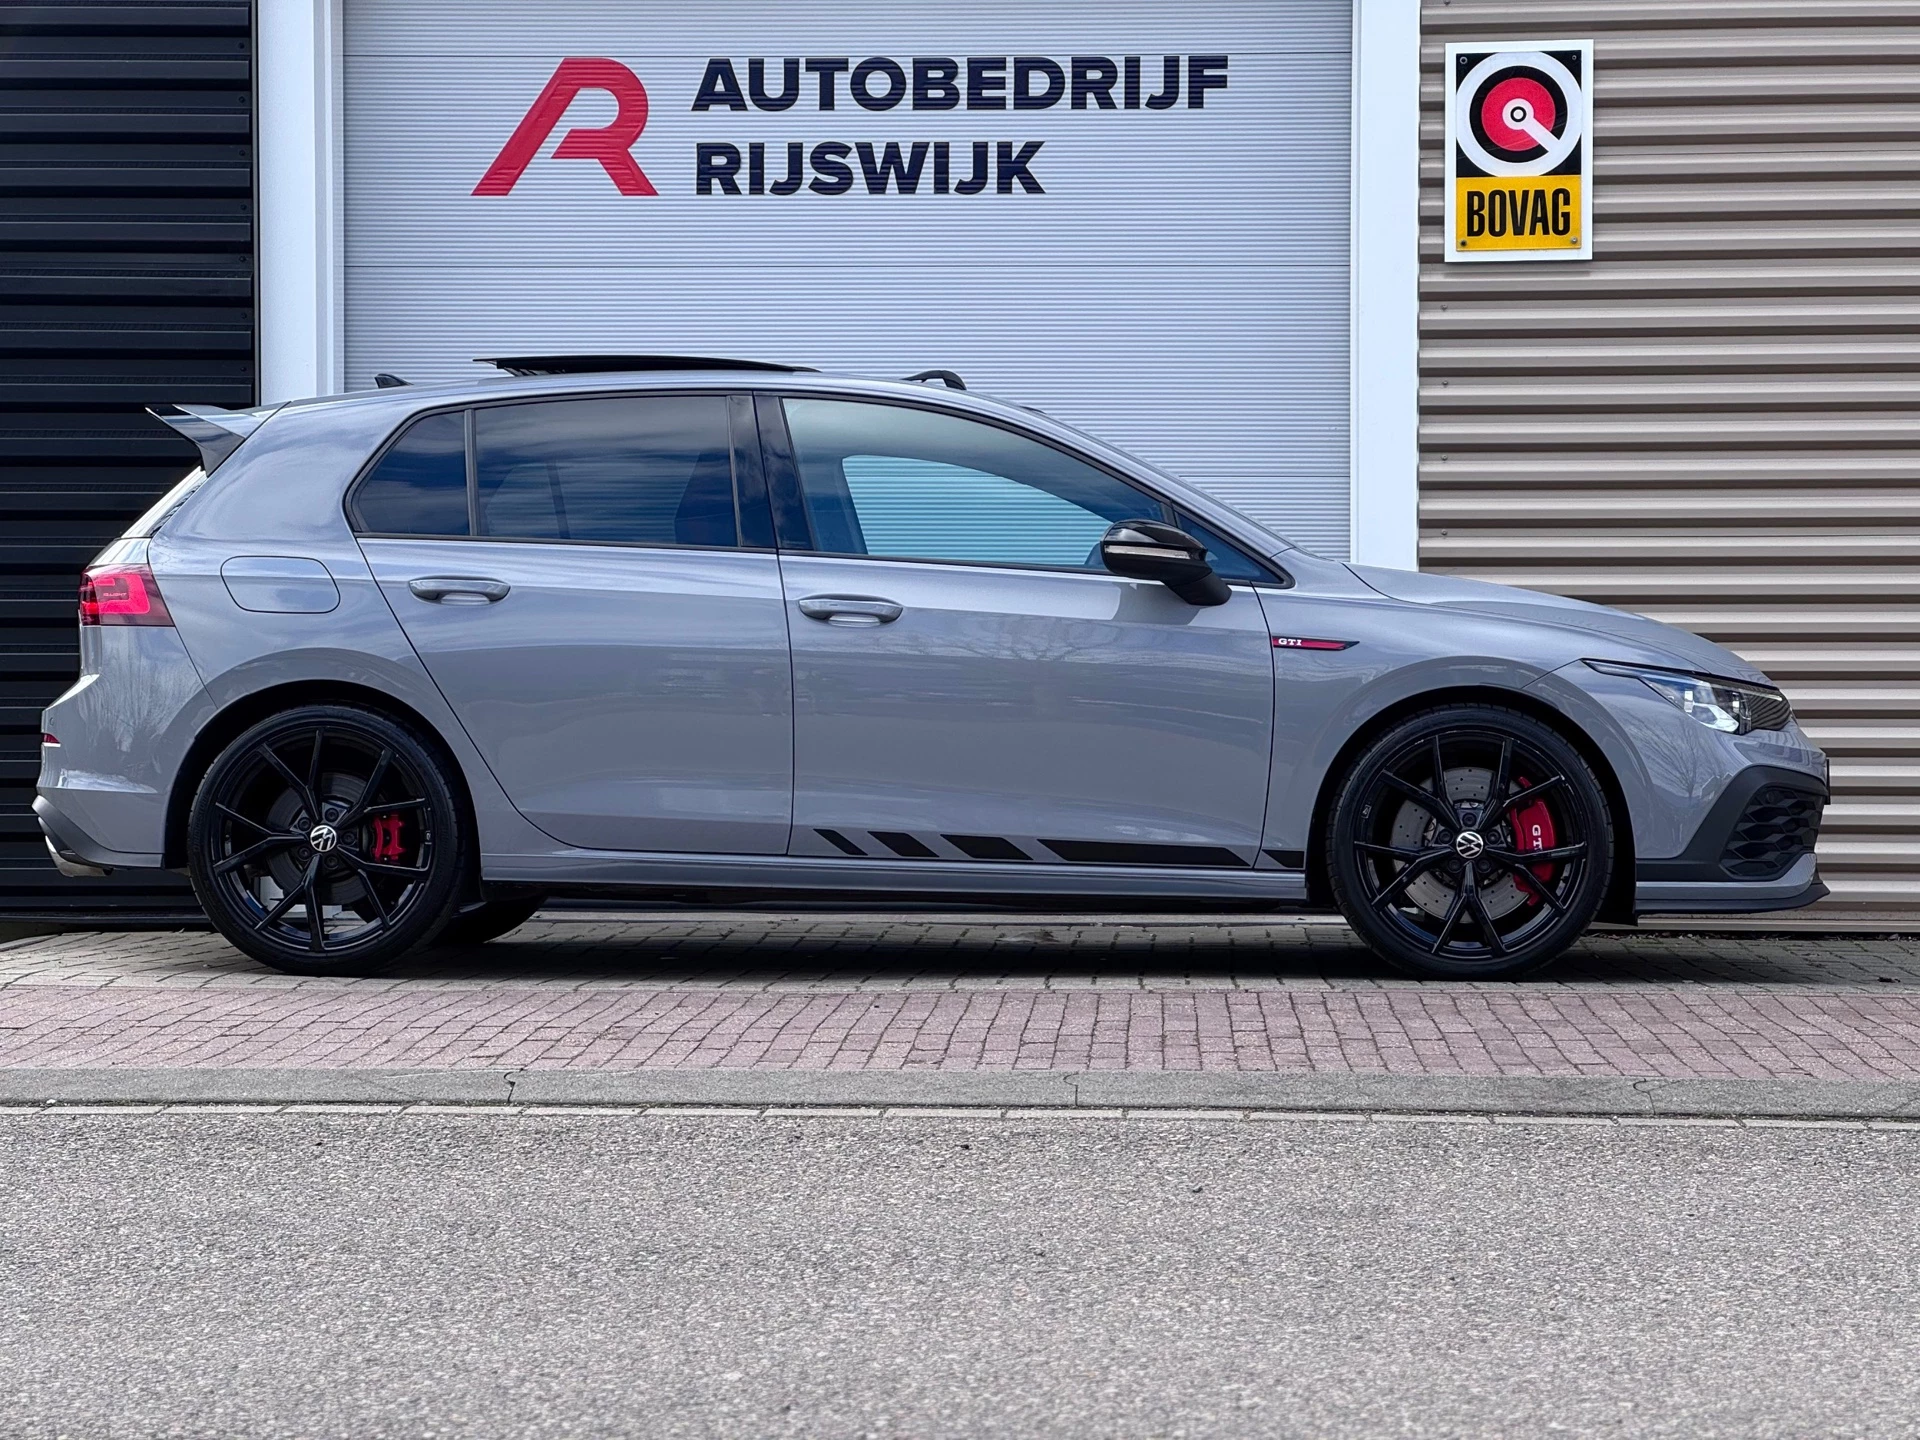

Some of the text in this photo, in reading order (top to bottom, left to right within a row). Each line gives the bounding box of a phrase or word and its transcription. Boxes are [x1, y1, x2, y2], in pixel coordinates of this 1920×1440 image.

[691, 55, 1228, 112] AUTOBEDRIJF
[696, 141, 1045, 195] RIJSWIJK
[1466, 188, 1571, 237] BOVAG
[1278, 638, 1302, 646] GTI
